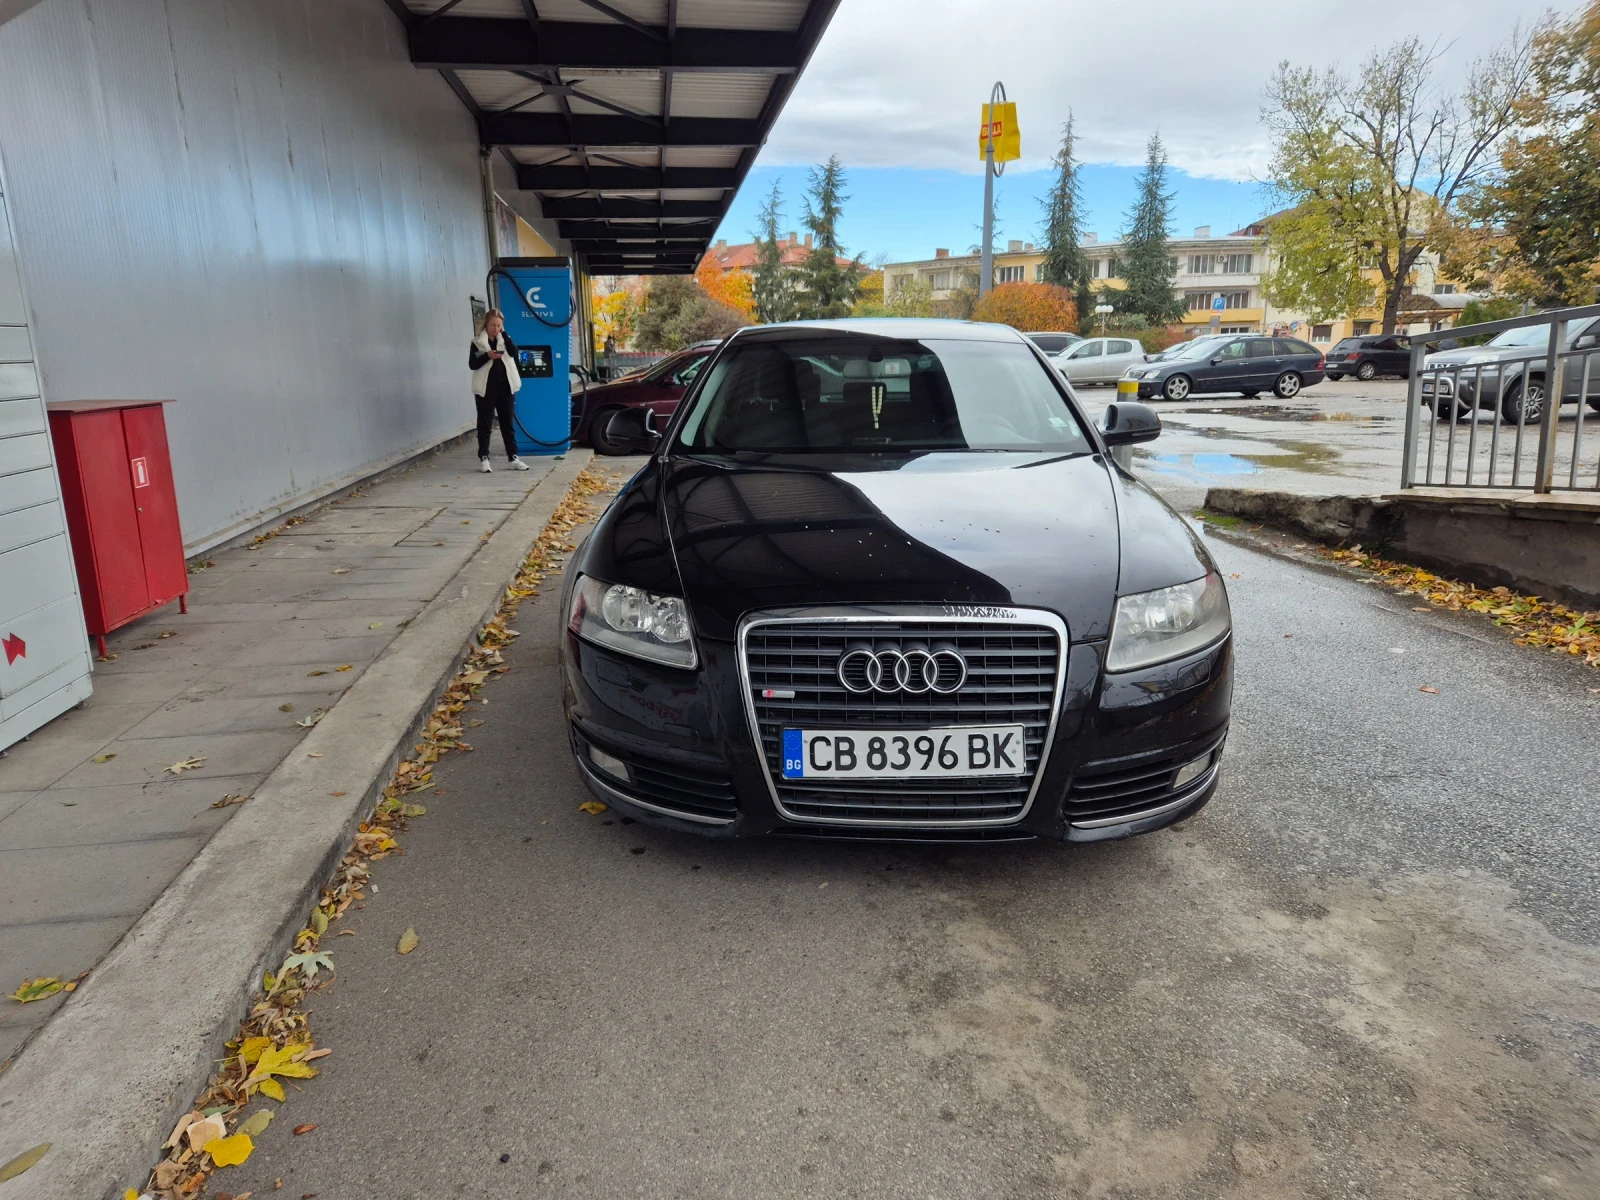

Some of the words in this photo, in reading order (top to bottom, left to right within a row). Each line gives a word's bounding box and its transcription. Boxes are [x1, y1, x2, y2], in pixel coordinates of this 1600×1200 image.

[981, 124, 1002, 137] BLA
[1215, 299, 1222, 308] P
[809, 736, 857, 771] CB
[866, 734, 959, 771] 8396
[968, 732, 1016, 770] BK
[786, 759, 801, 770] BG
